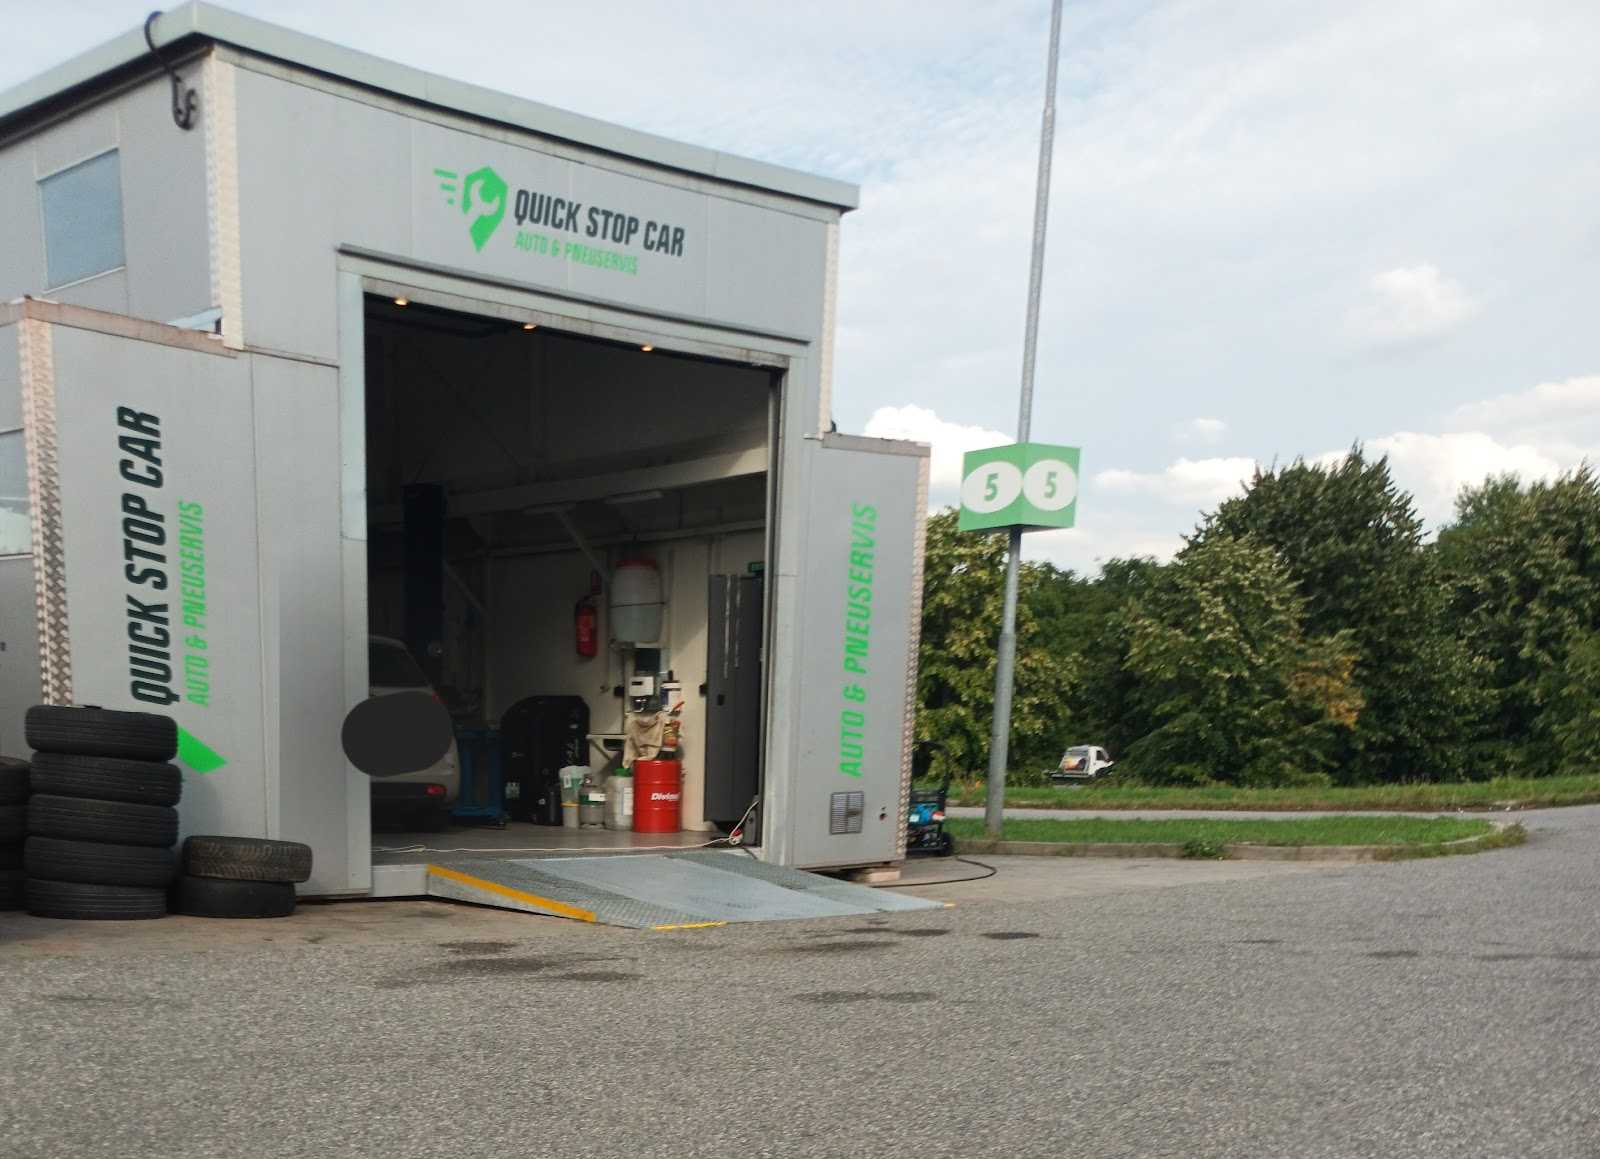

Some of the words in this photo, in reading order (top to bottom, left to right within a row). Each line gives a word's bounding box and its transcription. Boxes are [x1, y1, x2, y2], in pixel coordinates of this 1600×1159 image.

[514, 189, 582, 234] QUICK
[586, 206, 639, 245] STOP
[643, 221, 685, 257] CAR
[515, 231, 548, 256] AUTO
[551, 240, 561, 257] &
[564, 242, 638, 275] PNEUSERVIS
[117, 406, 163, 488] CAR
[984, 473, 999, 502] 5
[1044, 472, 1057, 499] 5
[121, 493, 168, 590] STOP
[178, 500, 206, 628] PNEUSERVIS
[844, 503, 878, 675] PNEUSERVIS
[126, 593, 180, 705] QUICK
[184, 634, 208, 650] &
[184, 655, 209, 708] AUTO
[842, 684, 866, 703] &
[839, 710, 864, 778] AUTO
